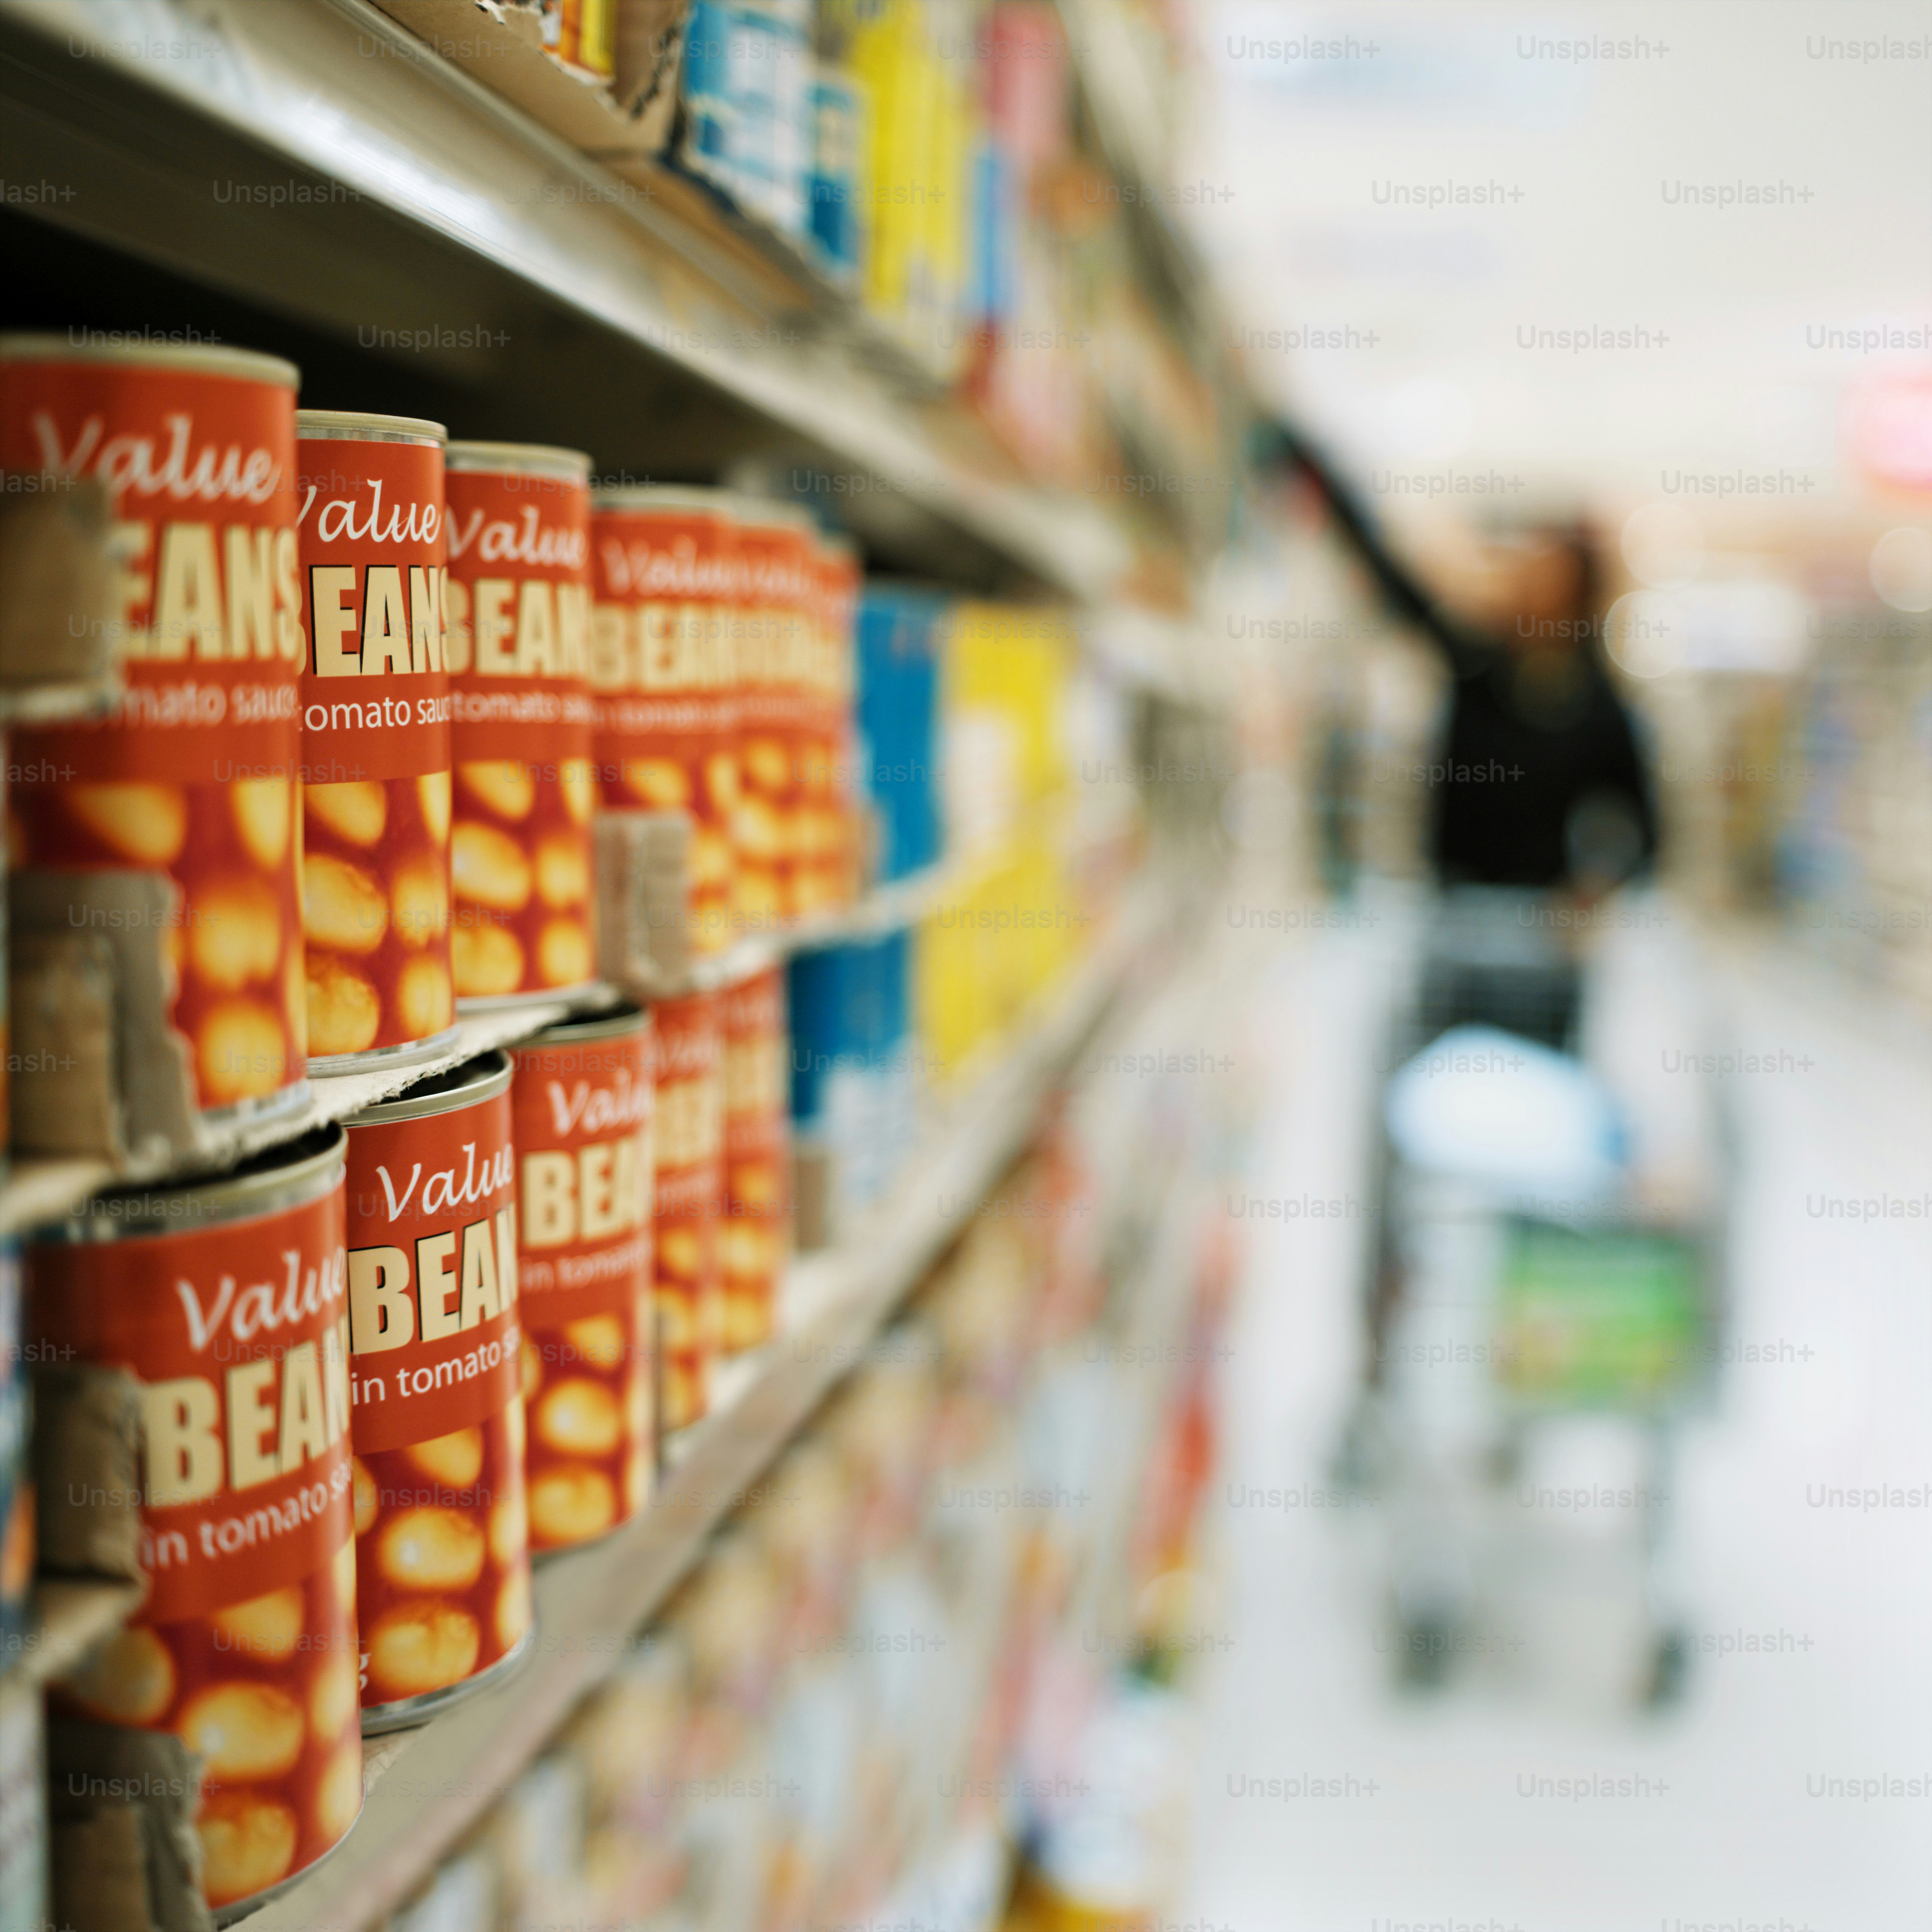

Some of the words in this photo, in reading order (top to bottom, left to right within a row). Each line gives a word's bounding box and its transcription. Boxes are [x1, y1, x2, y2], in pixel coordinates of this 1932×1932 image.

[31, 410, 280, 505] Value
[299, 697, 411, 731] omato
[376, 1141, 514, 1223] Value
[177, 1246, 347, 1352] Value
[352, 1372, 385, 1405] in
[397, 1340, 501, 1398] tomato
[200, 1482, 328, 1559] tomato
